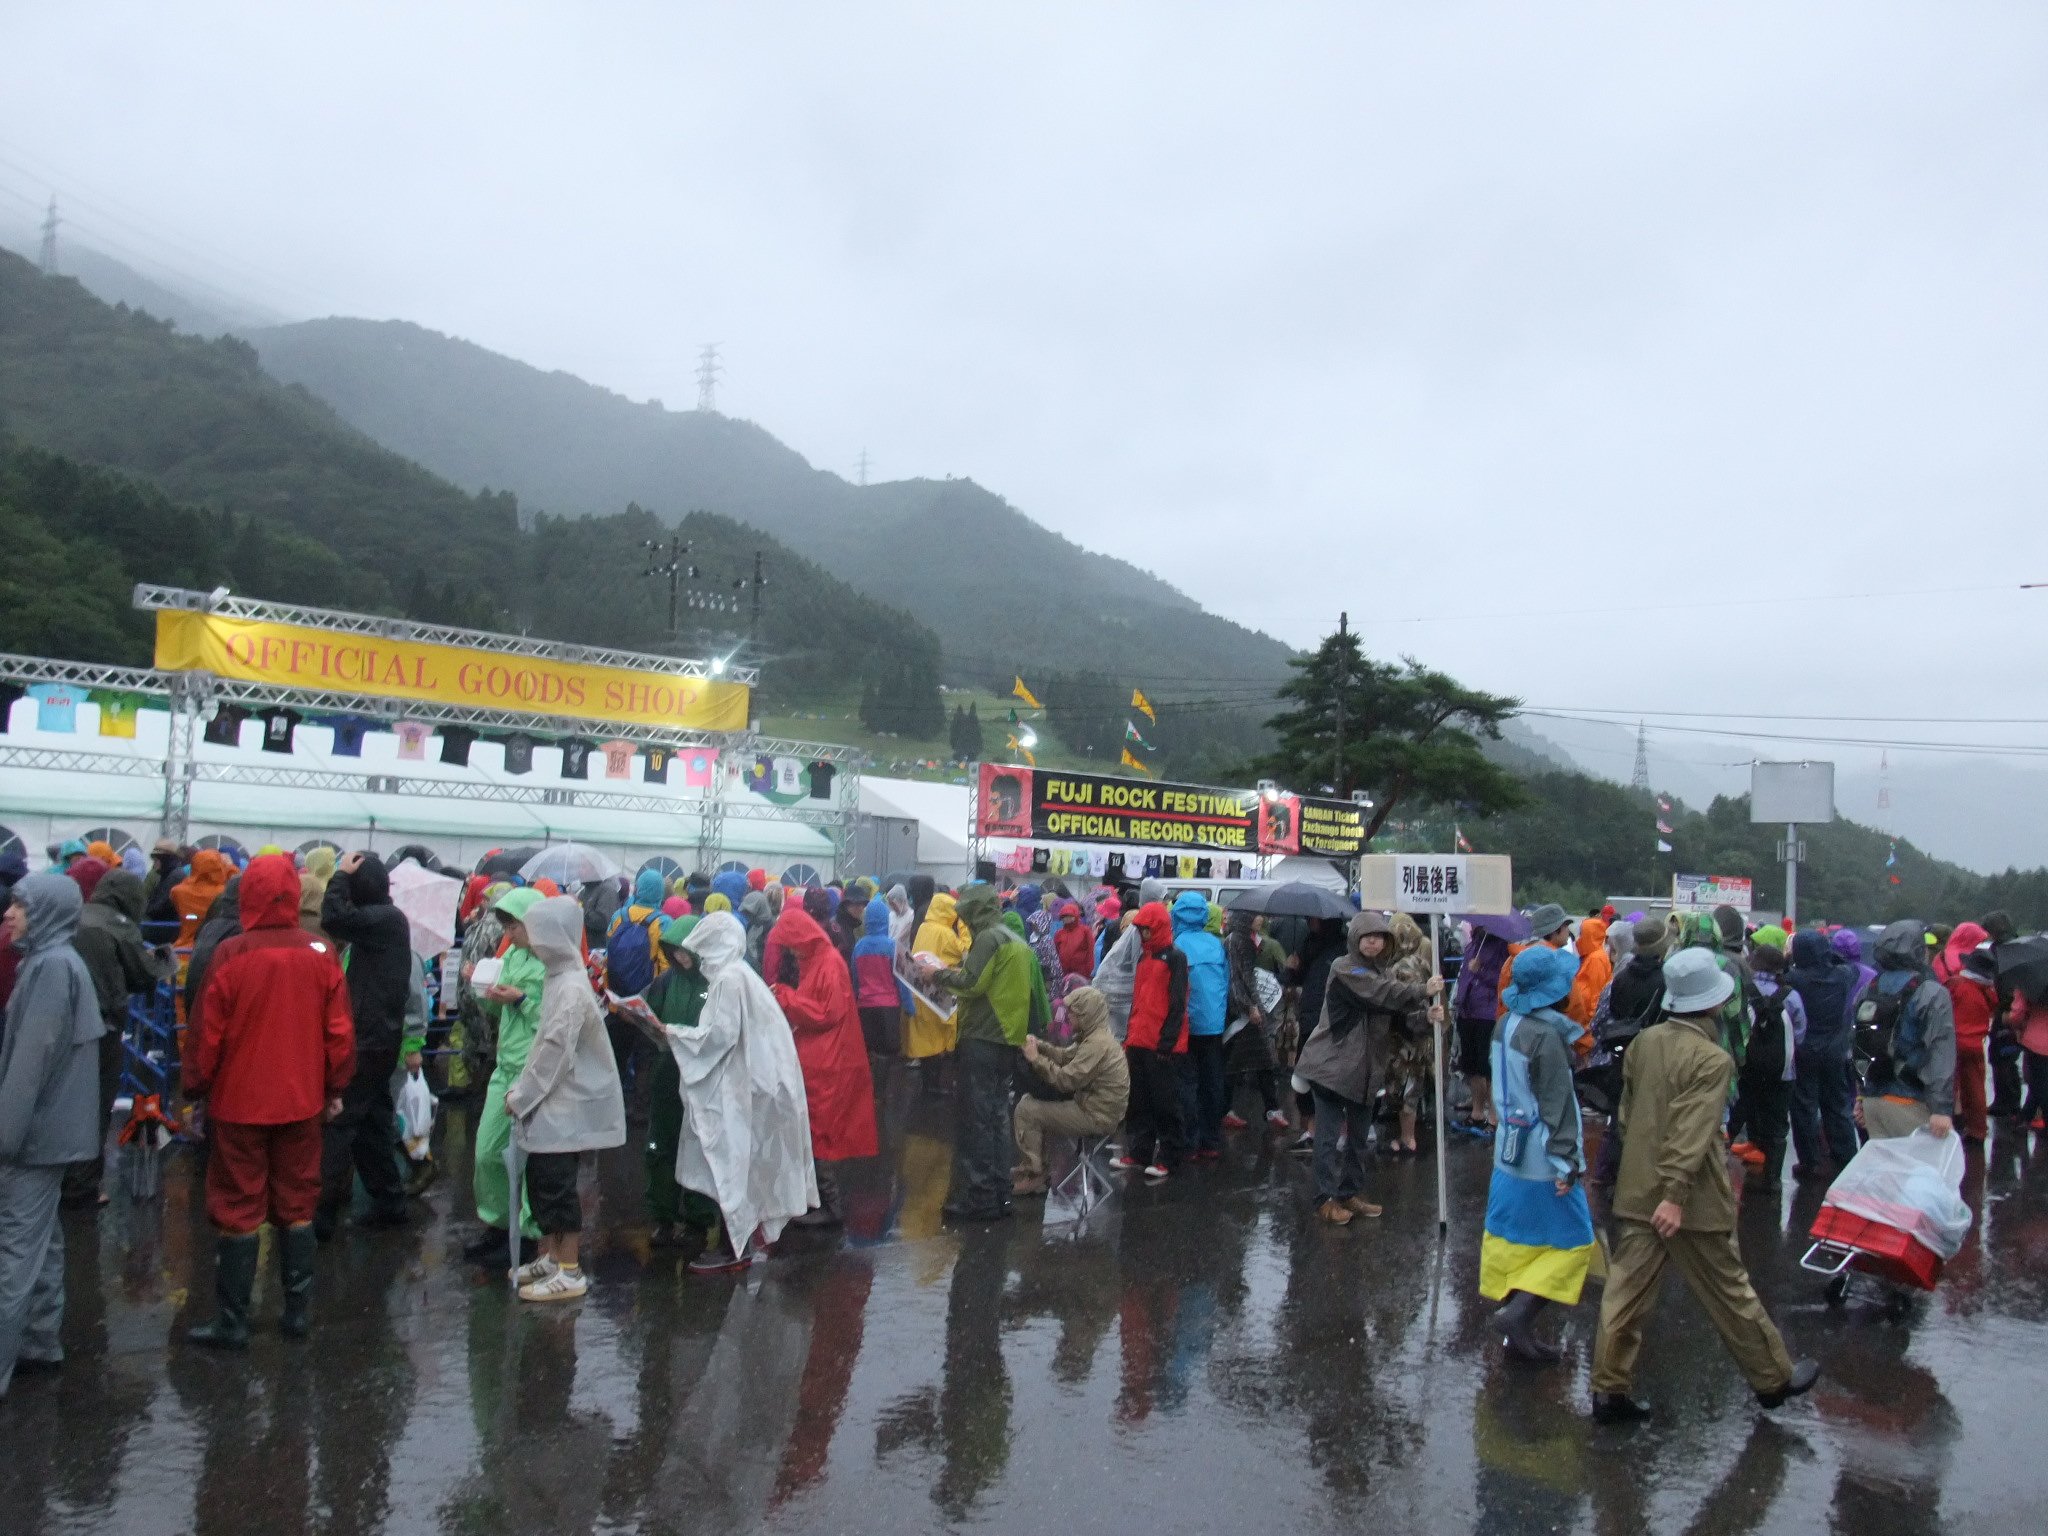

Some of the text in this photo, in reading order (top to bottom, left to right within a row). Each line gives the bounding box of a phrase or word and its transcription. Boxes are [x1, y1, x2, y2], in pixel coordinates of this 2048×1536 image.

[226, 633, 698, 717] OFFICIAL GOODS SHOP
[1046, 780, 1248, 818] FUJI ROCK FESTIVAL
[1046, 813, 1126, 839] OFFICIAL
[1129, 821, 1194, 843] RECORD
[1197, 825, 1247, 846] STORE
[1402, 865, 1459, 895] 列最後尾
